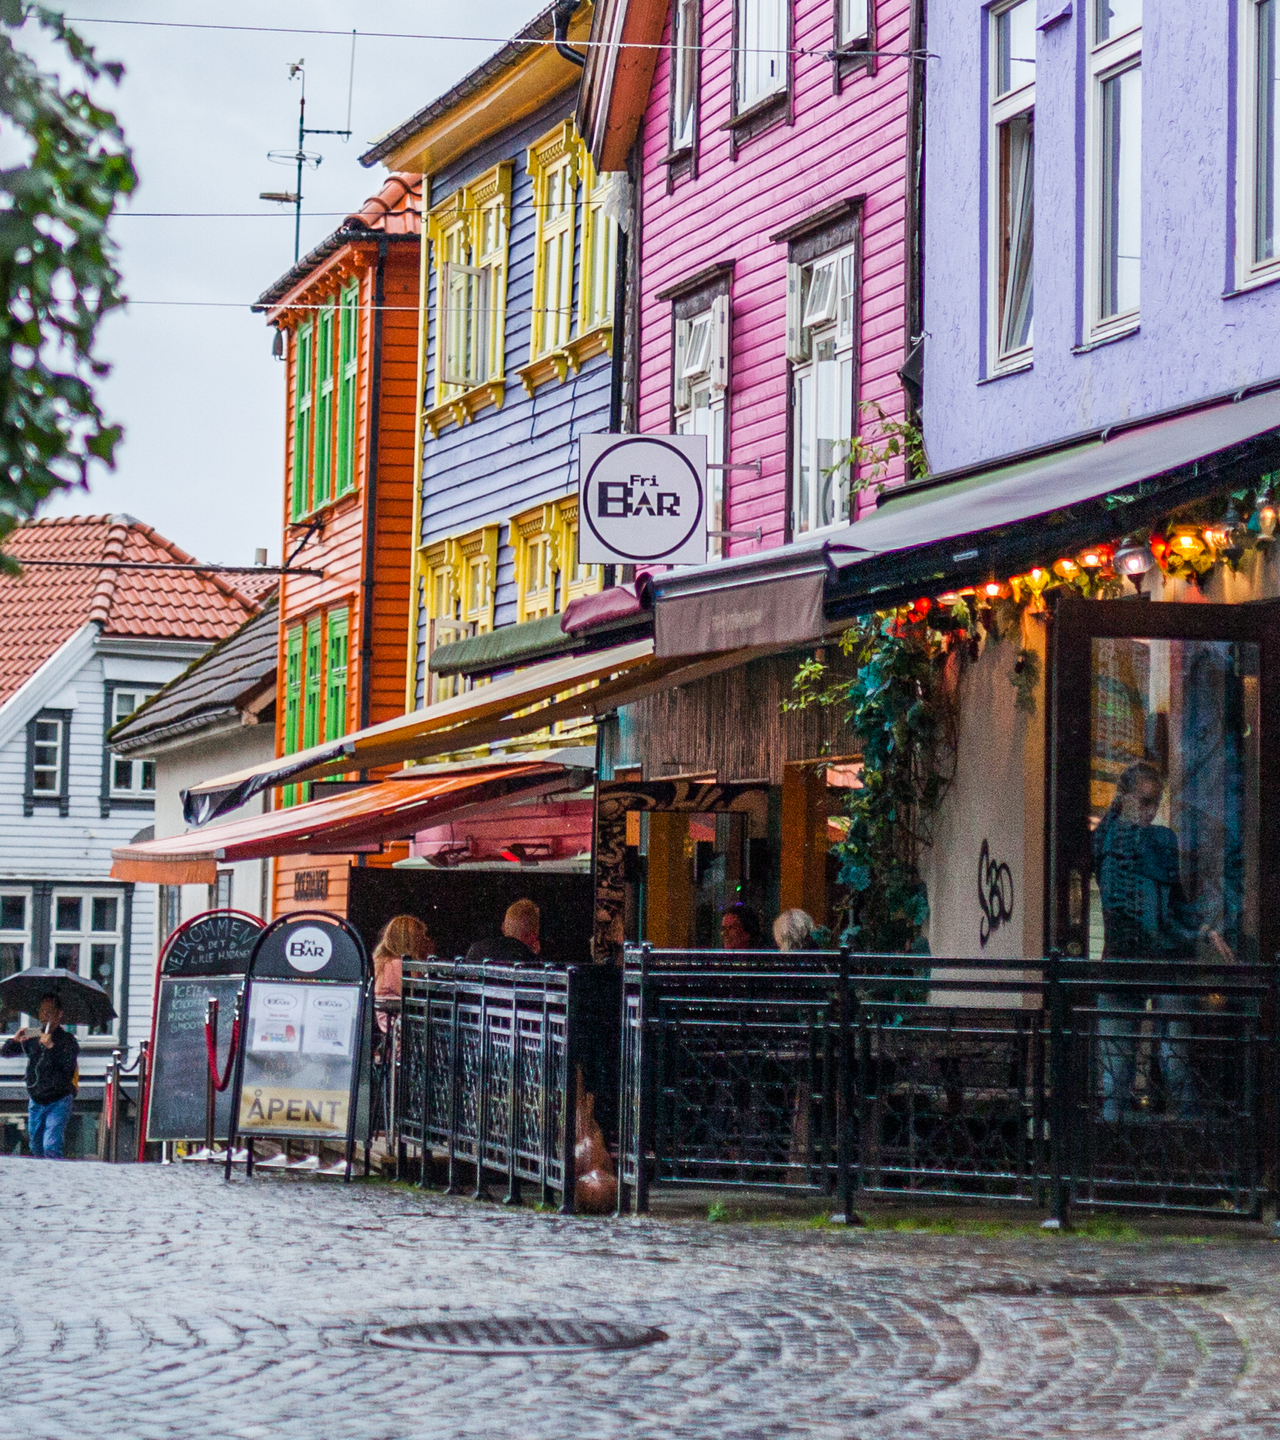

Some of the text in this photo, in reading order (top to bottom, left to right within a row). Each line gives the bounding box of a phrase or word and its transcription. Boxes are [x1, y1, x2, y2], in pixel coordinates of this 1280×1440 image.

[630, 475, 659, 486] Fri
[598, 481, 680, 518] BAR
[290, 942, 324, 957] BAR
[247, 1089, 342, 1123] ÅPENT
